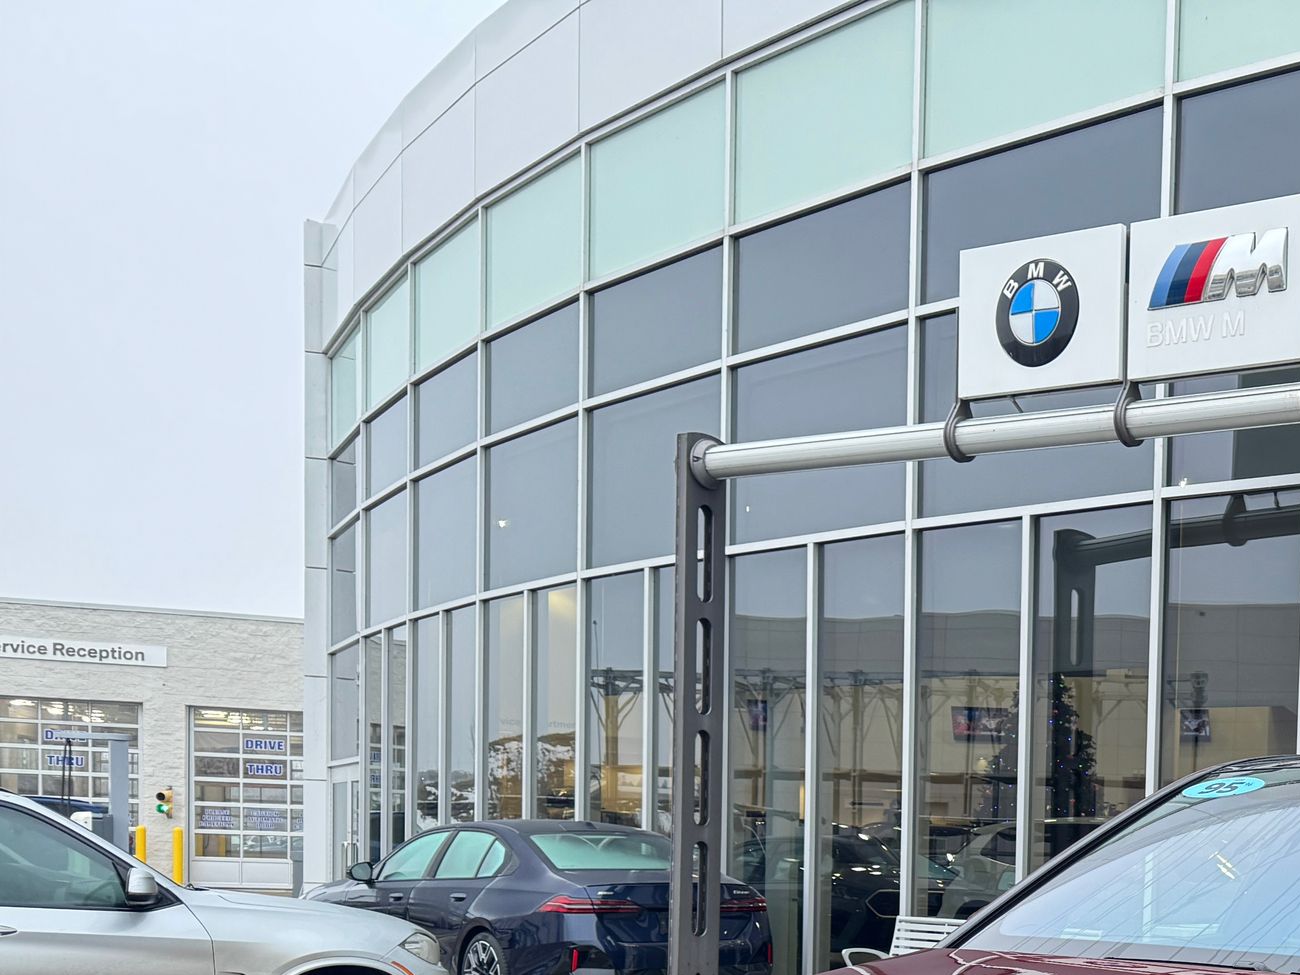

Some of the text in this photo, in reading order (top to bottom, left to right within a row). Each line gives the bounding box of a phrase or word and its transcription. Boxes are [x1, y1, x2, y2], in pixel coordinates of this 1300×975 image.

[1145, 310, 1246, 348] BMW M
[0, 640, 145, 661] rvice Reception
[245, 739, 285, 751] DRIVE
[248, 764, 282, 775] THRU
